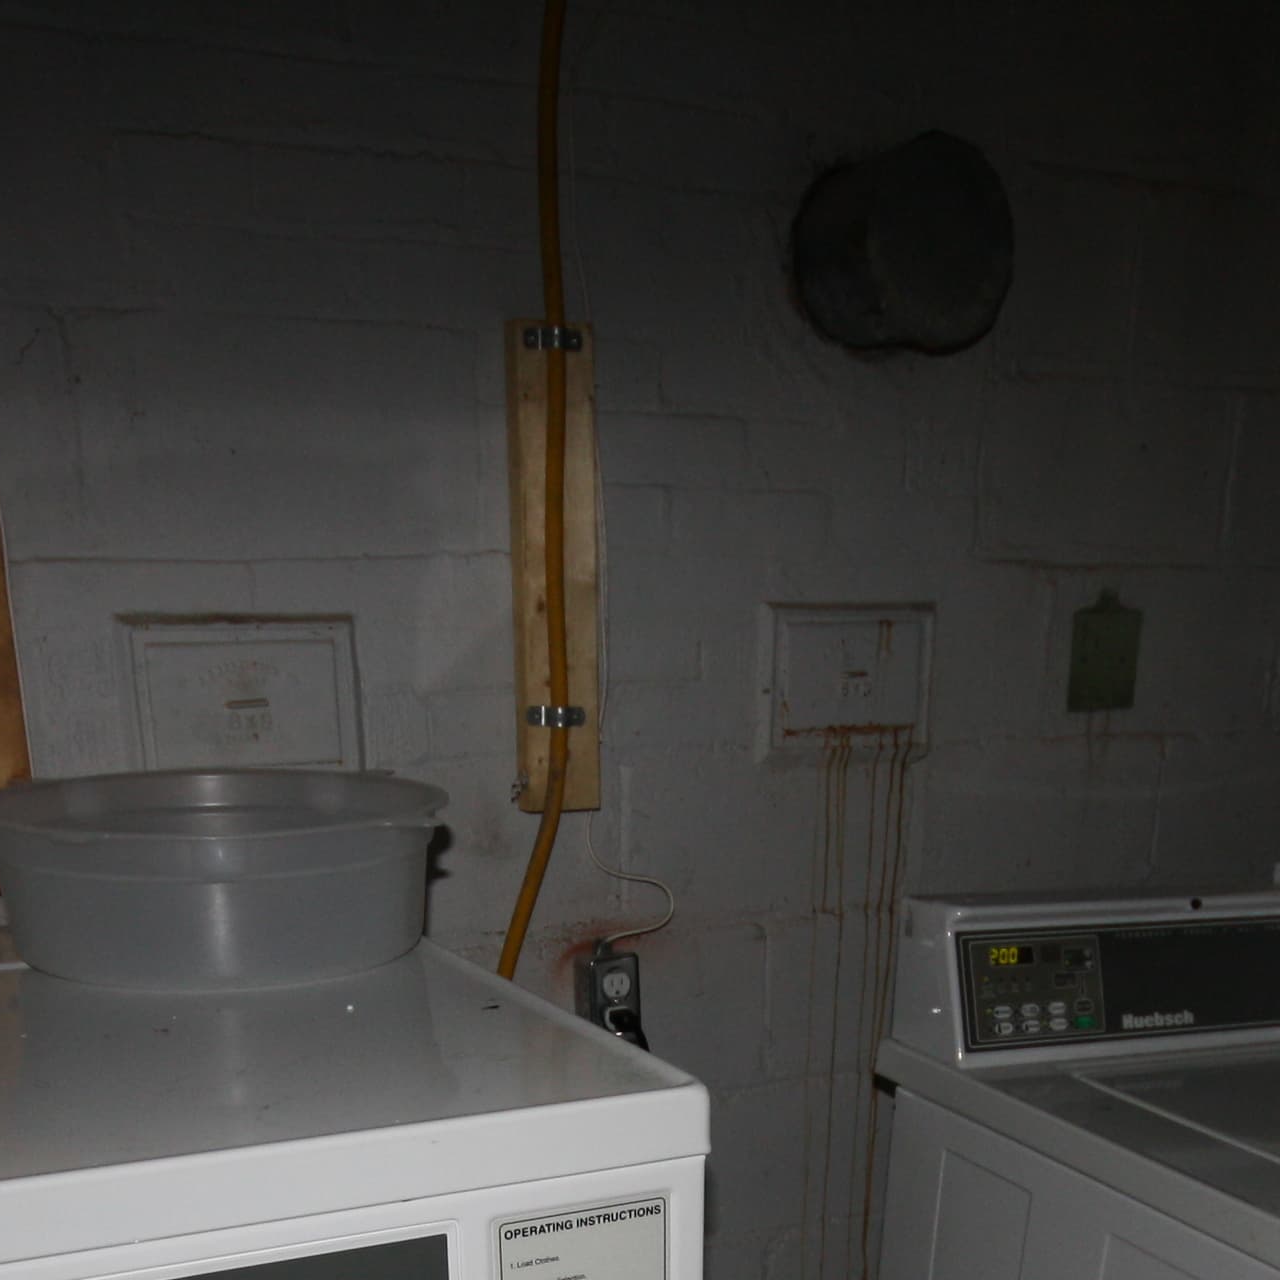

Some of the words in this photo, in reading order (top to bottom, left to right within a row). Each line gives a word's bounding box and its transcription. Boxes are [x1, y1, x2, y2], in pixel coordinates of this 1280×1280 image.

[1122, 1009, 1195, 1030] Huebsch
[504, 1220, 573, 1240] OPERATING
[576, 1205, 662, 1227] INSTRUCTIONS
[517, 1260, 533, 1268] Load
